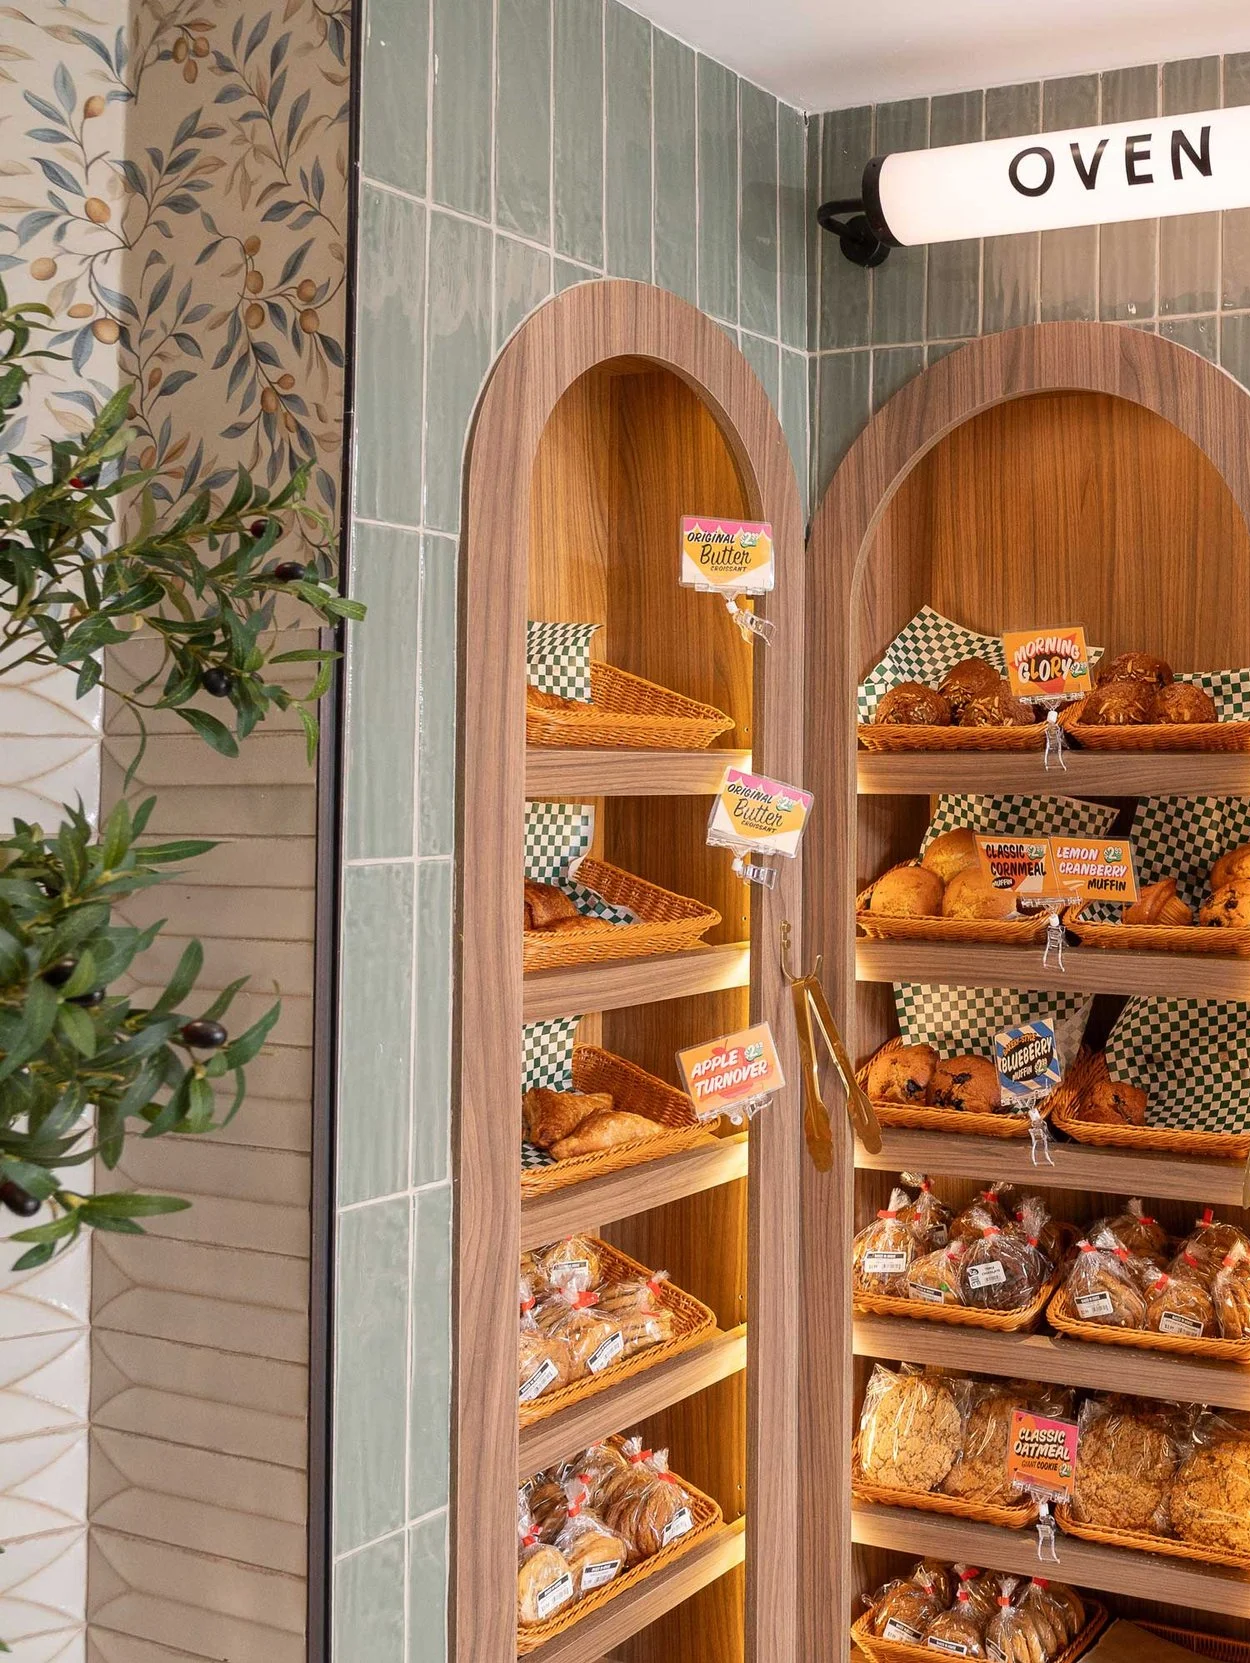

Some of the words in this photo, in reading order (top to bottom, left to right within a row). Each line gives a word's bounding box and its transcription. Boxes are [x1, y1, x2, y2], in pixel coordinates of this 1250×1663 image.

[1007, 125, 1214, 199] OVEN
[687, 531, 735, 544] ORIGINAL
[700, 543, 751, 565] Butter
[1014, 636, 1080, 667] MORNING
[1018, 656, 1072, 684] GLORY
[727, 783, 773, 805] ORIGINAL
[733, 798, 784, 828] Butter
[741, 819, 778, 834] CROISSANT
[986, 844, 1025, 859] CLASSIC
[1056, 846, 1099, 861] LEMON
[990, 861, 1047, 877] CORNMEAL
[1059, 862, 1128, 878] CRANBERRY
[992, 877, 1014, 888] MUFFIN
[1087, 878, 1127, 892] MUFFIN
[1002, 1036, 1053, 1074] BLUEBERRY
[691, 1049, 739, 1079] APPLE
[694, 1060, 769, 1097] TURNOVER
[1012, 1065, 1033, 1082] MUFFIN
[1019, 1427, 1066, 1444] CLASSIC
[1013, 1441, 1070, 1461] OATMEAL
[1037, 1461, 1058, 1471] COOKIE
